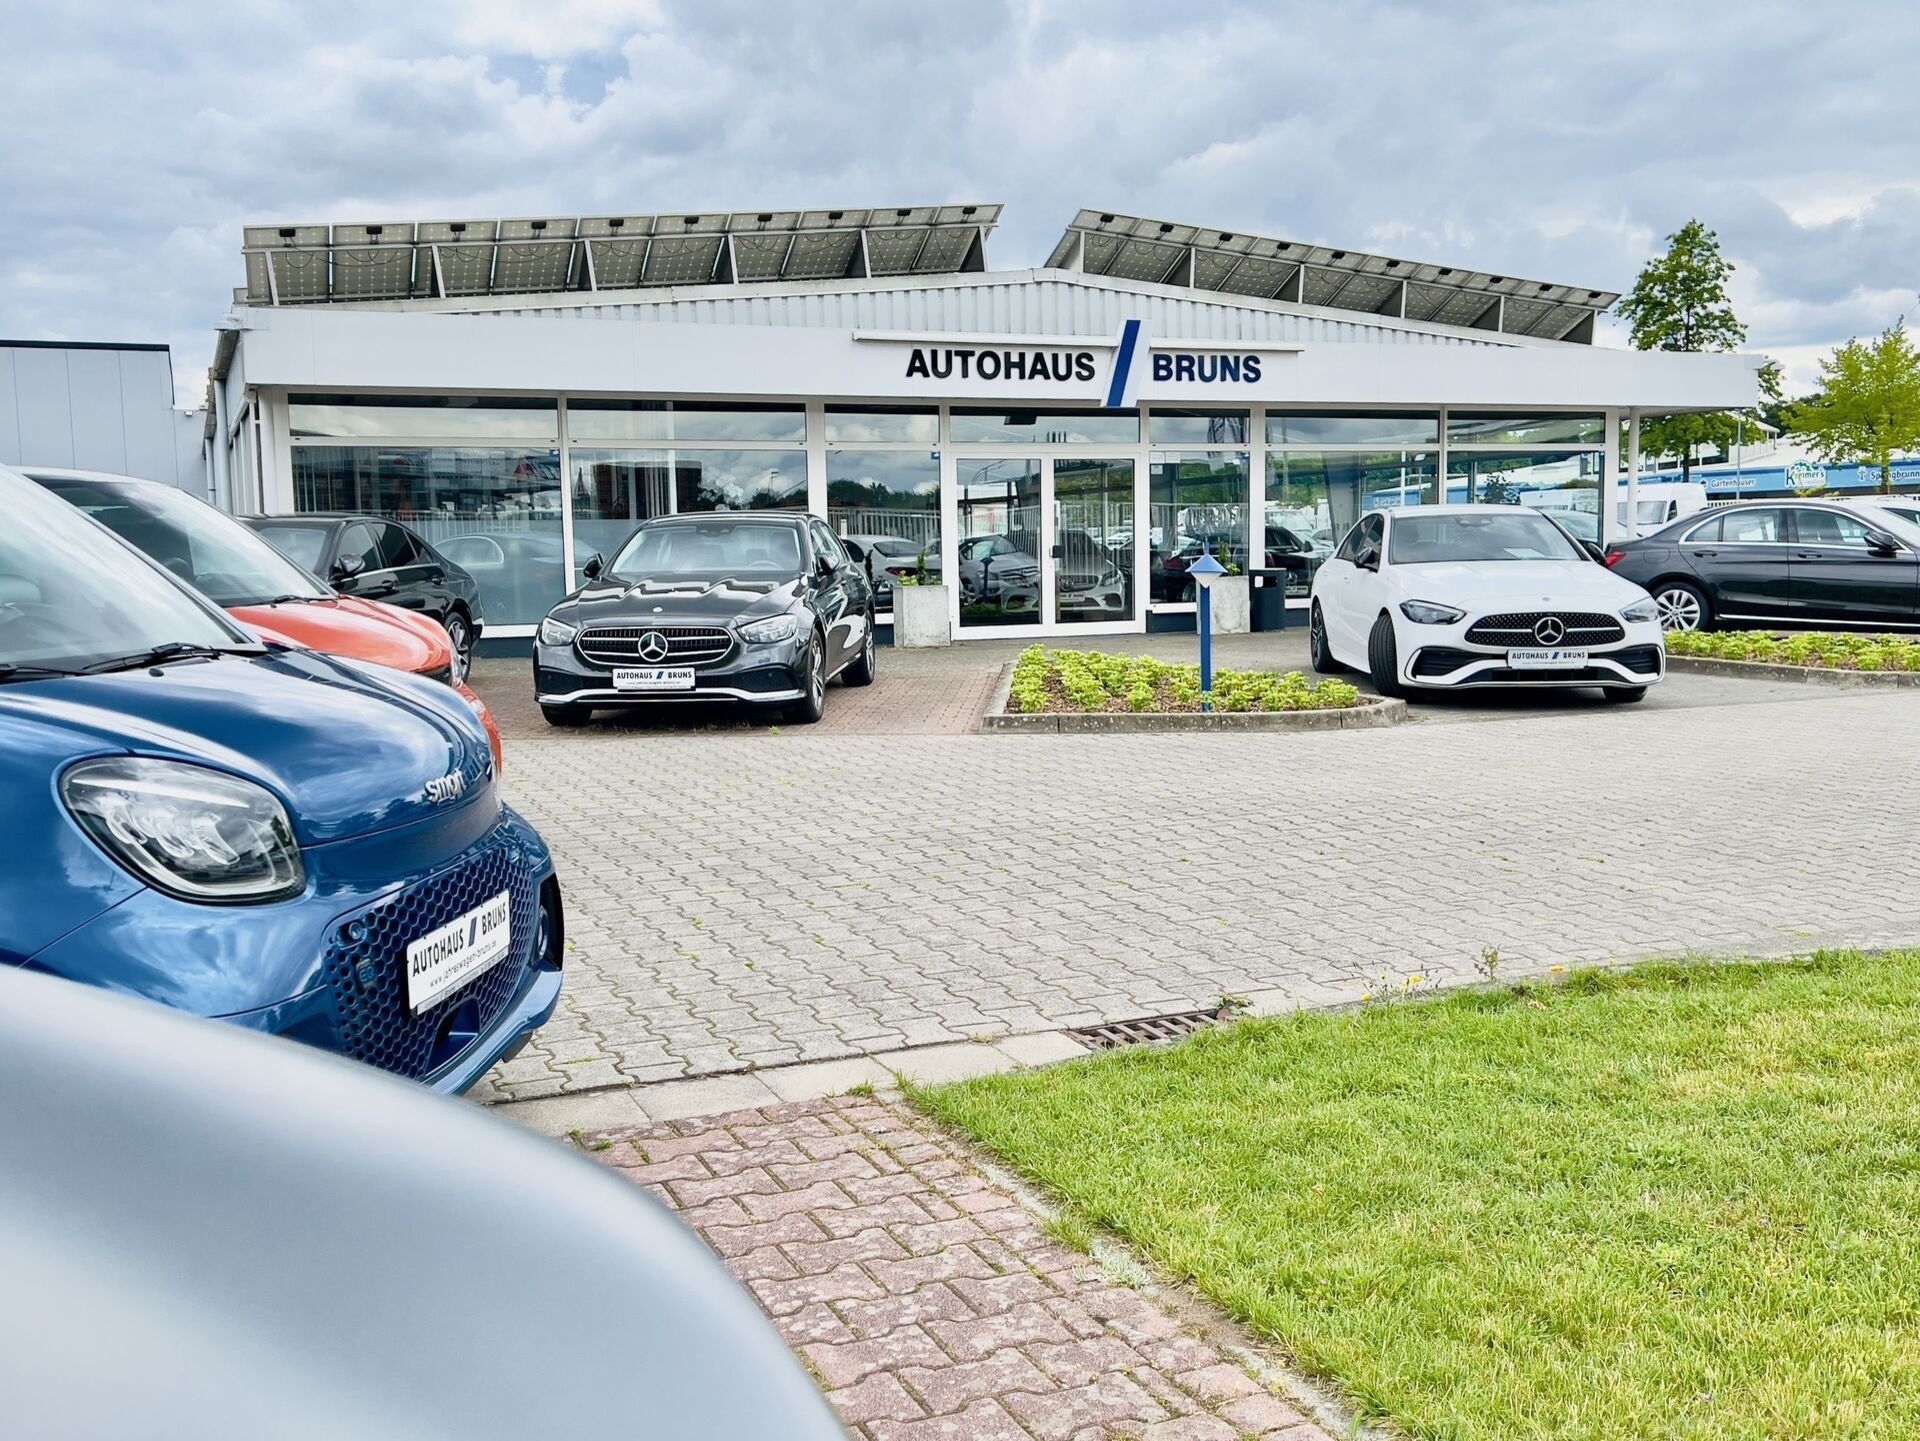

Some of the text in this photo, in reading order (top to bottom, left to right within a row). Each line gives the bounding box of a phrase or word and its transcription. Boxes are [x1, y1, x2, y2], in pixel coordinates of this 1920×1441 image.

[905, 348, 1262, 383] AUTOHAUS BRUNS
[1563, 651, 1585, 659] BRUNS
[616, 671, 692, 679] AUTOHAUS BRUNS
[412, 902, 506, 977] AUTOHAUS BRUNS
